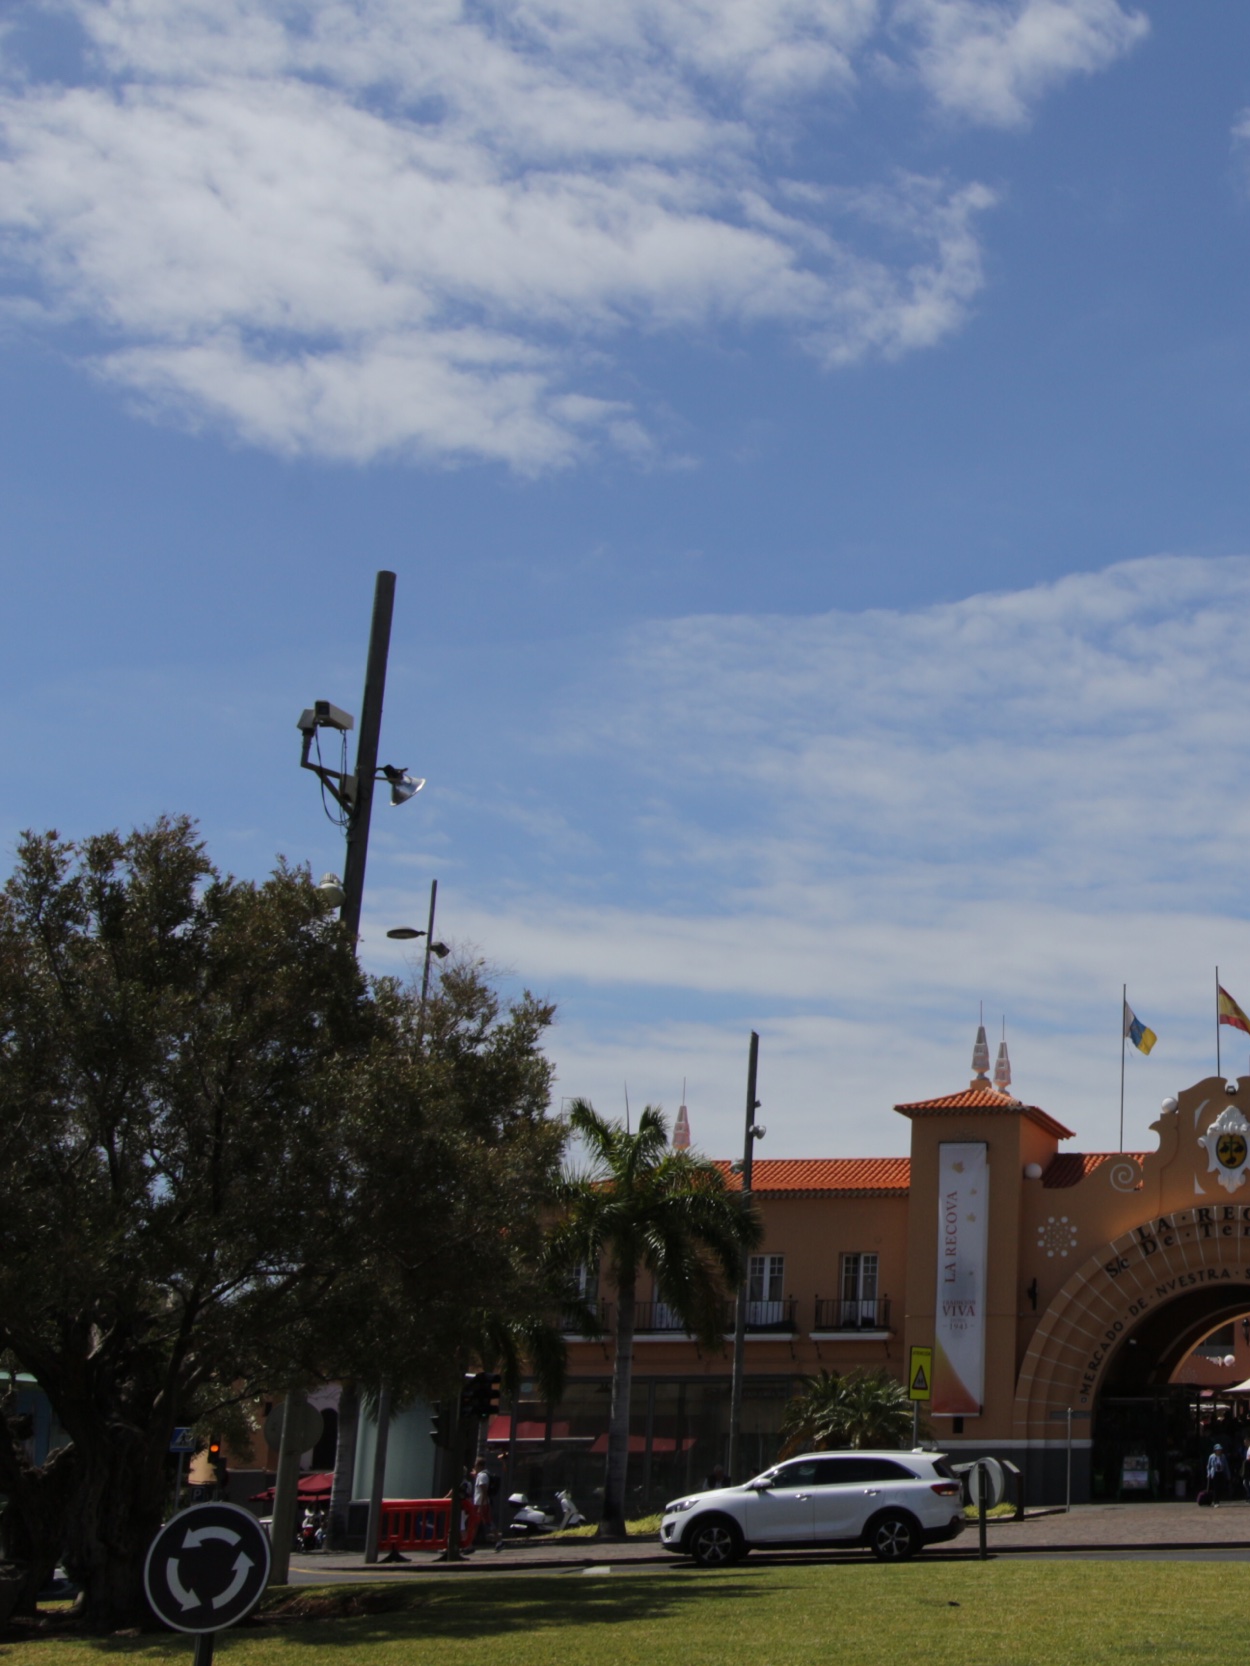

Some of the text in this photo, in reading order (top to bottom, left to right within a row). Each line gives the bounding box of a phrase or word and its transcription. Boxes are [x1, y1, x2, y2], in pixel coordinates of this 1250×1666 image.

[945, 1190, 958, 1283] LA RECOVA
[1136, 1217, 1172, 1240] LA
[1141, 1234, 1174, 1256] De
[942, 1305, 977, 1317] VIVA
[1080, 1321, 1124, 1396] MERCADO
[1128, 1298, 1148, 1317] DE
